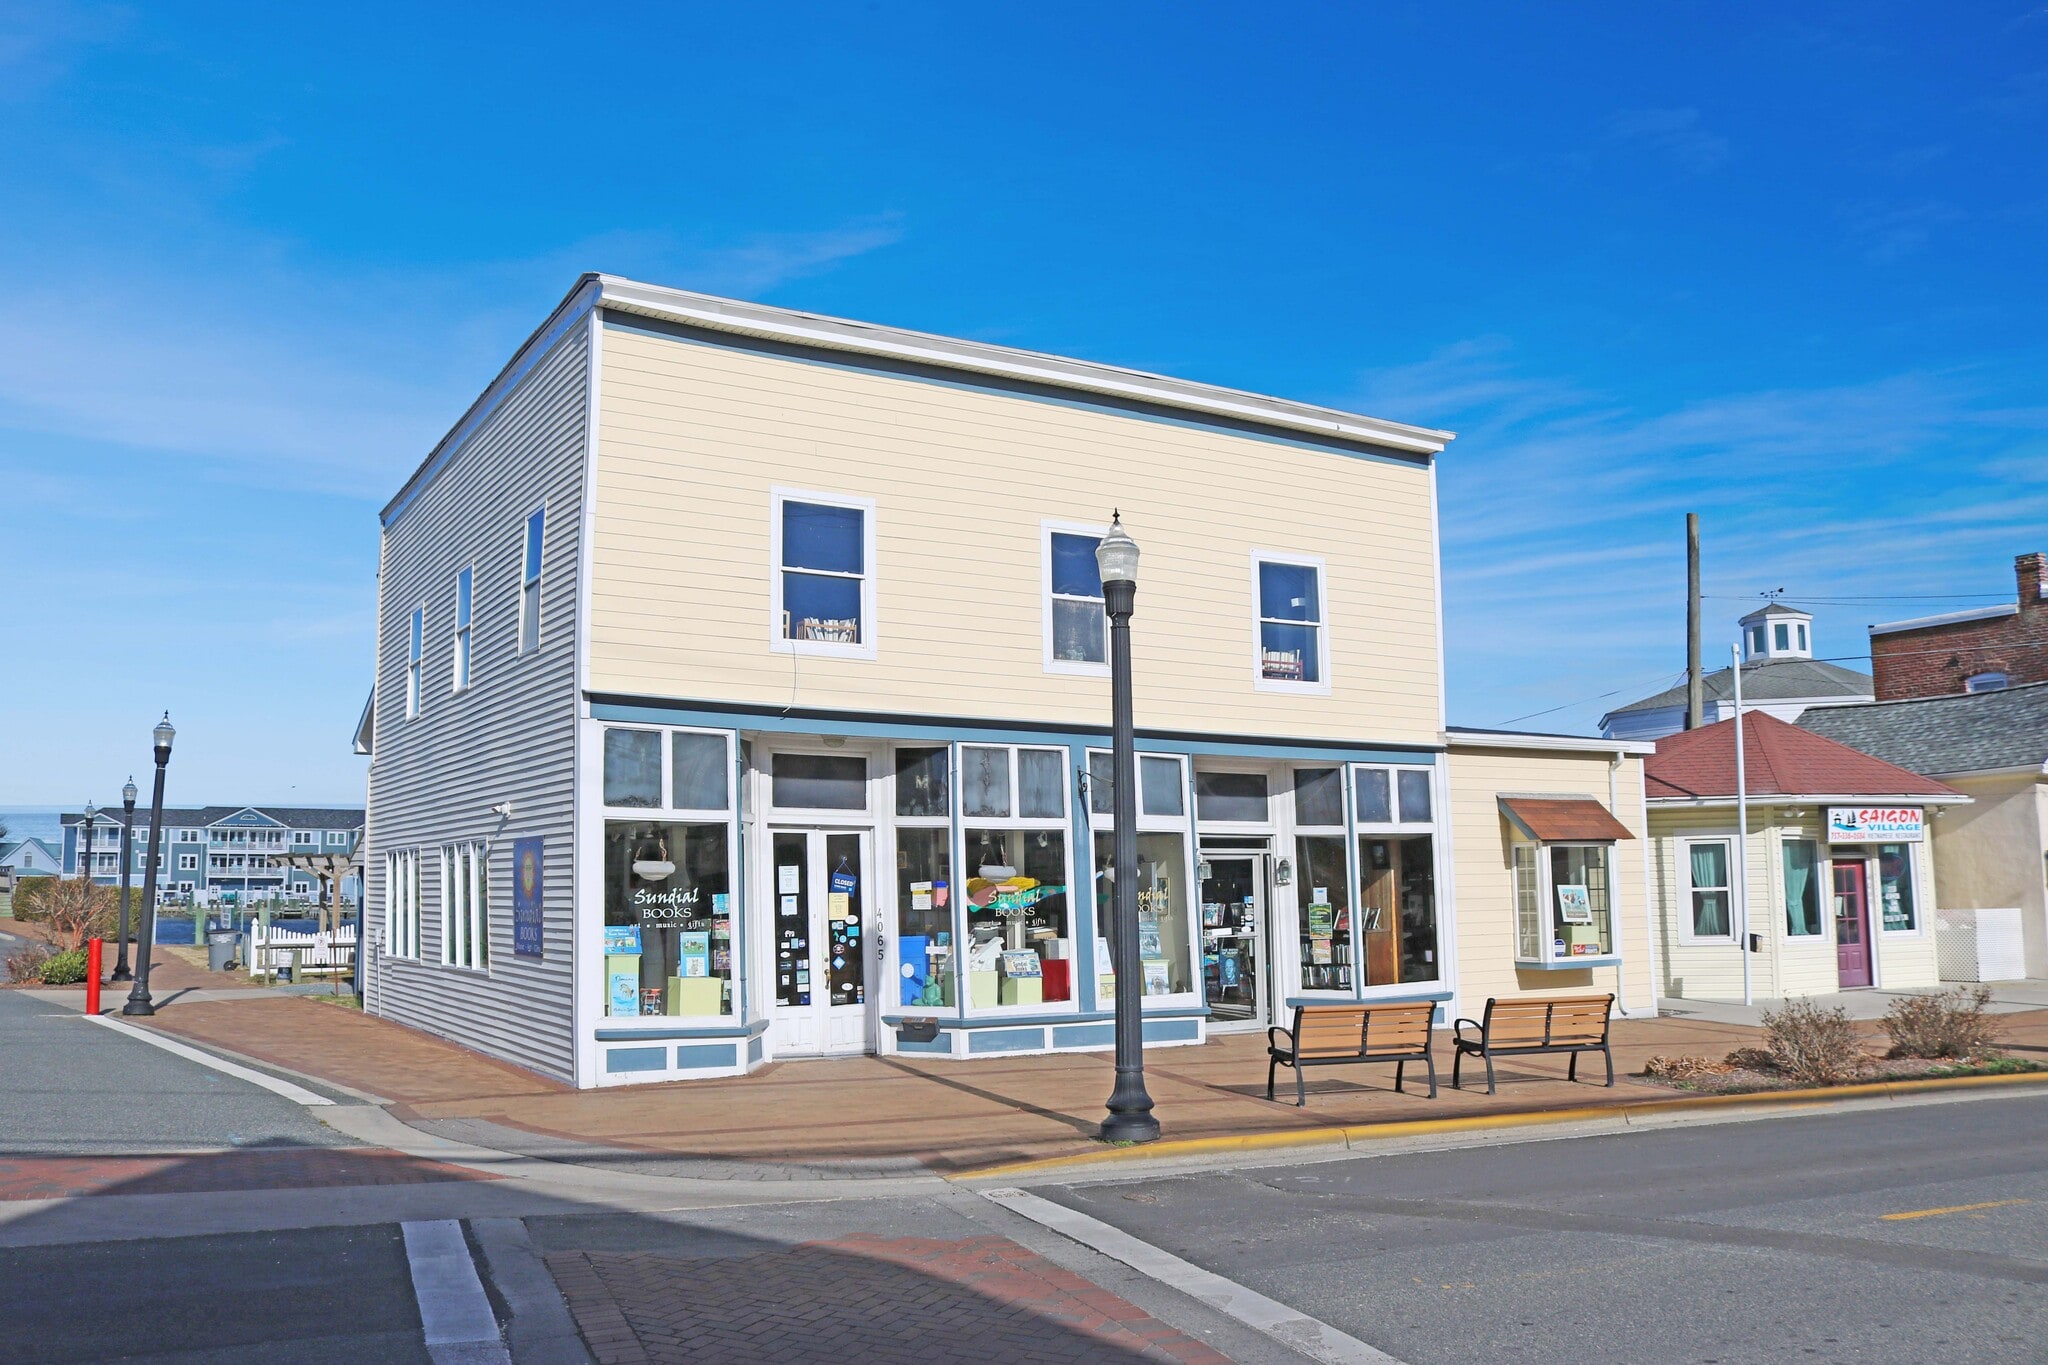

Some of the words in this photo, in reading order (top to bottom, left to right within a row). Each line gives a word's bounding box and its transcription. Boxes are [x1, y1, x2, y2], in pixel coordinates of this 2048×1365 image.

[1859, 809, 1920, 823] SAIGON
[834, 878, 853, 886] CLOSED
[634, 887, 699, 908] Sundial
[988, 888, 1040, 904] Sundial
[515, 901, 542, 924] Sundial
[643, 908, 692, 919] BOOKS
[995, 907, 1035, 917] BOOKS
[656, 921, 677, 929] music
[687, 920, 705, 929] gifts
[1031, 917, 1046, 926] gifts
[520, 926, 538, 941] BOOKS
[876, 908, 884, 961] 4065
